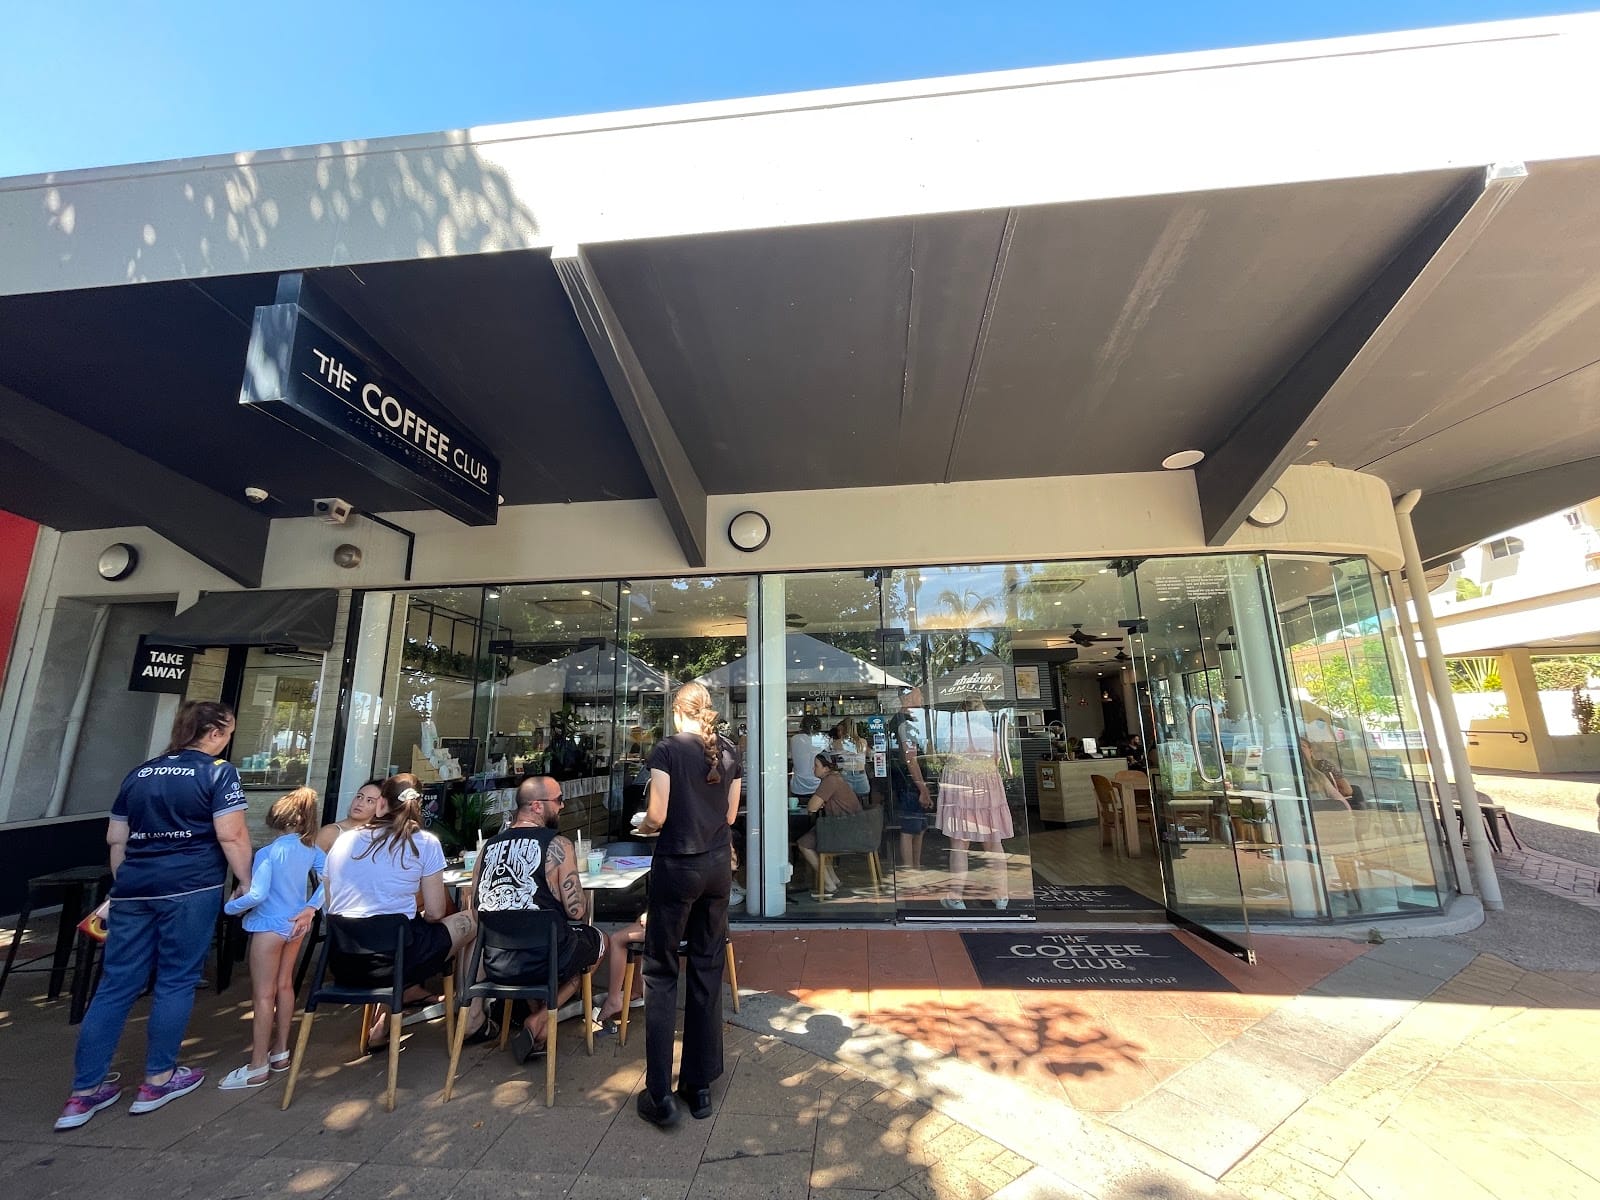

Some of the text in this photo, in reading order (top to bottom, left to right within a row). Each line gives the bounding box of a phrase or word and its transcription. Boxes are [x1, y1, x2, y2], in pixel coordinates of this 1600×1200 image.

[313, 348, 357, 392] THE
[362, 383, 450, 462] COFFEE
[453, 448, 488, 485] CLUB
[150, 651, 185, 665] TAKE
[142, 665, 186, 679] AWAY
[154, 767, 195, 776] TOYOTA
[1042, 934, 1089, 944] THE
[1010, 944, 1150, 957] COFFEE
[1053, 958, 1127, 970] CLUB
[1026, 976, 1071, 984] Where
[1074, 976, 1098, 984] will
[1146, 976, 1177, 985] you?
